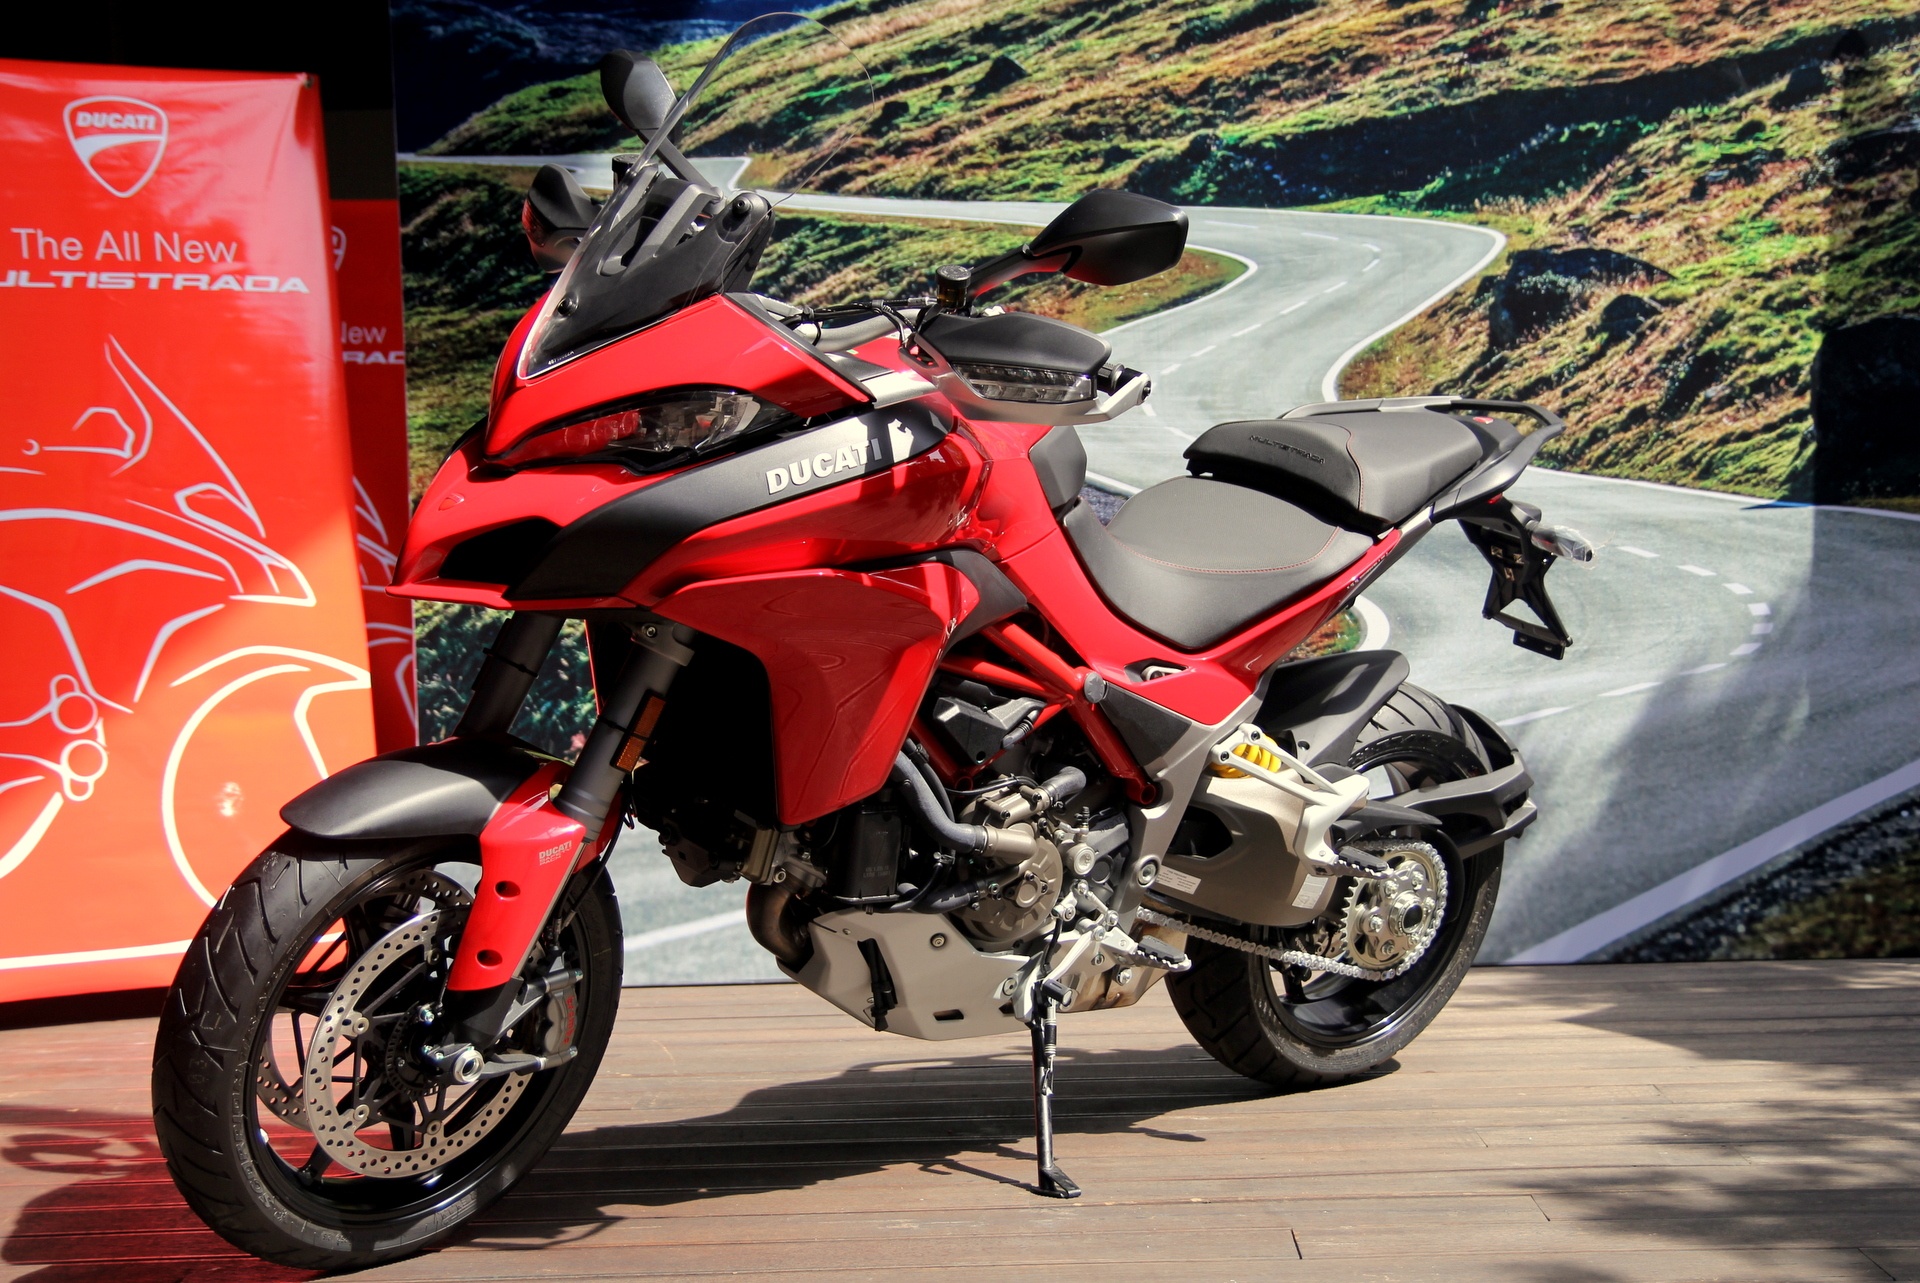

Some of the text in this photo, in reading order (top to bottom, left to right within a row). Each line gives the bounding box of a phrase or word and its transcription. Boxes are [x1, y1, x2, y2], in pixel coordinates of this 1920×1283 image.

[76, 111, 156, 130] DUCATI
[10, 227, 237, 263] The All New
[765, 437, 882, 495] DUCATI
[538, 840, 573, 859] DUCATI
